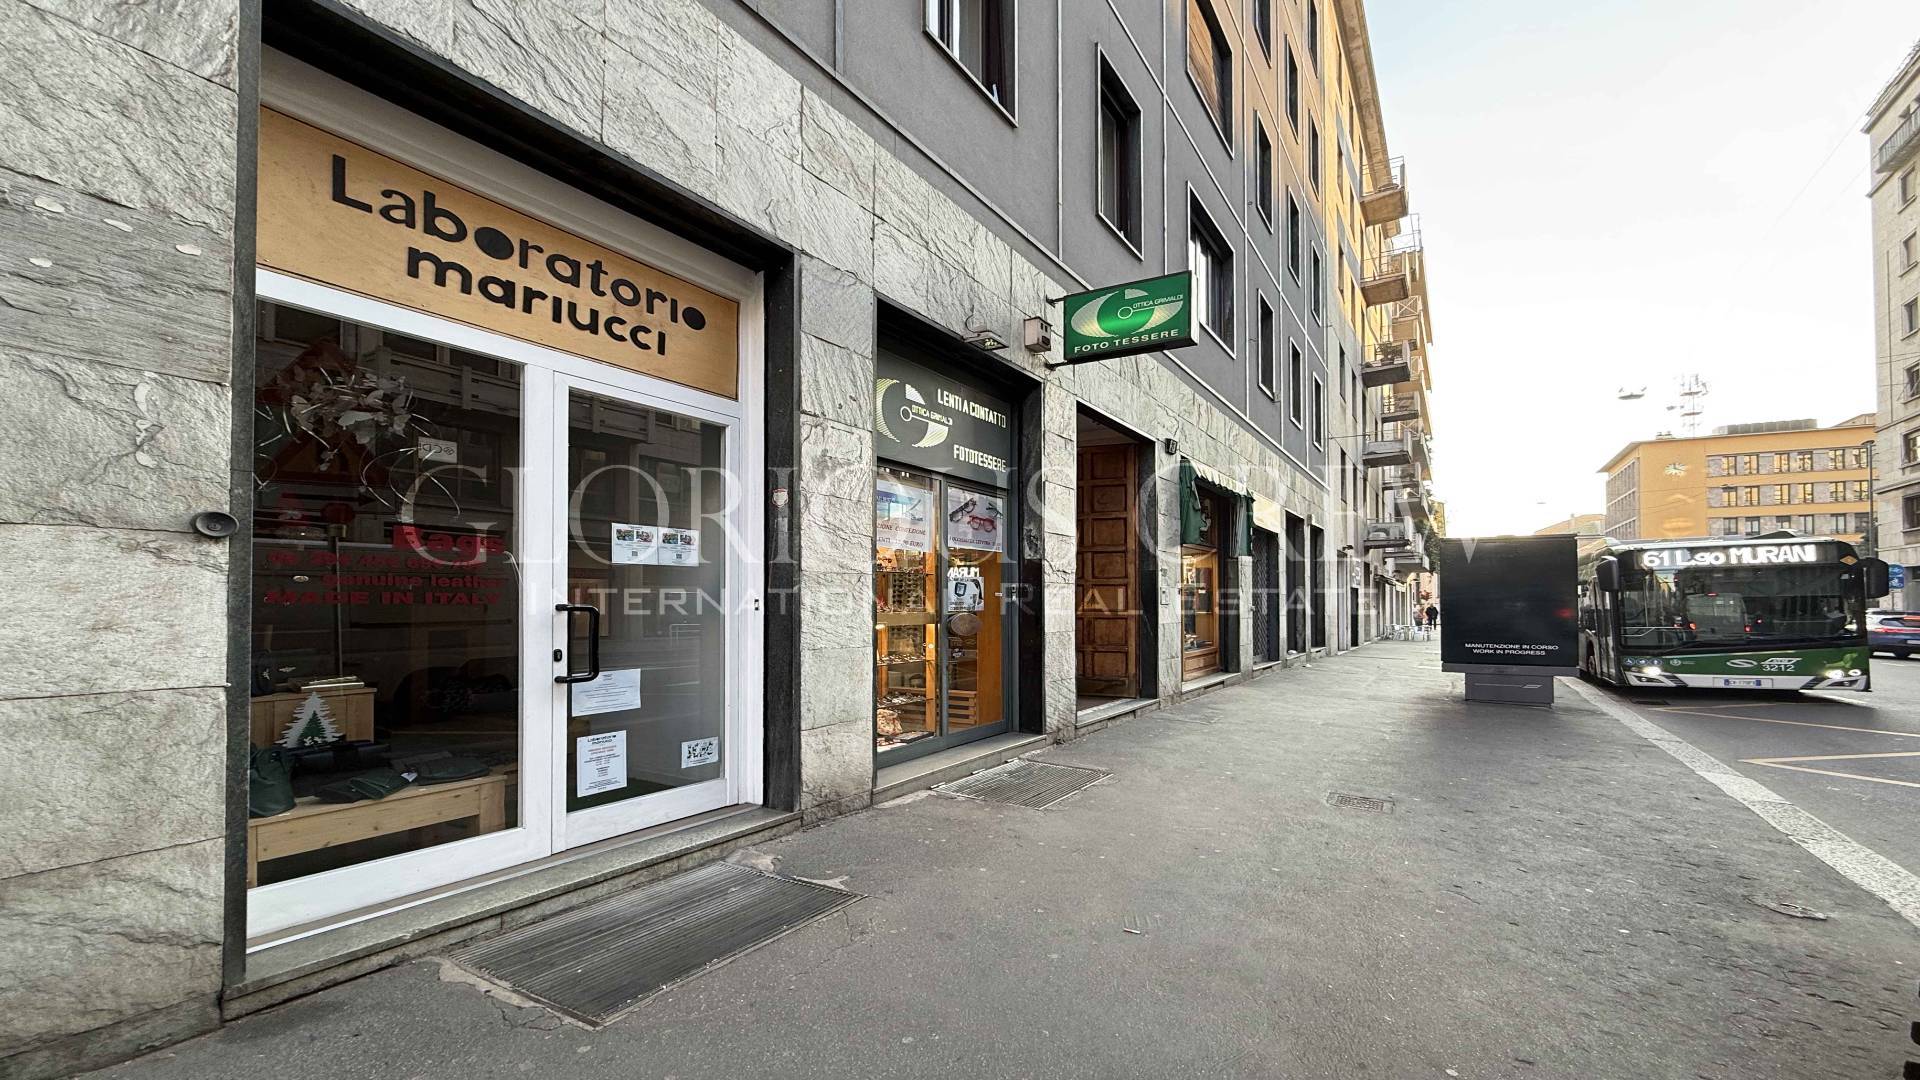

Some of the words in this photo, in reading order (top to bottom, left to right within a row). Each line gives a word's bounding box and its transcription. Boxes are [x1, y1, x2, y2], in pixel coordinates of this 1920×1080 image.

[332, 153, 706, 331] Laboratorio
[407, 246, 666, 357] mariucci
[1133, 301, 1153, 309] OTTICA
[1154, 294, 1184, 305] GRIMALDI
[1074, 341, 1109, 353] FOTO
[1113, 329, 1179, 346] TESSERE
[937, 388, 962, 411] LENTI
[963, 400, 969, 414] A
[969, 401, 1006, 428] CONTATTO
[953, 444, 1007, 473] FOTOTESSERE
[1642, 550, 1669, 568] 61
[382, 591, 414, 605] IN
[425, 591, 502, 606] ITALY
[1762, 664, 1796, 672] 3212
